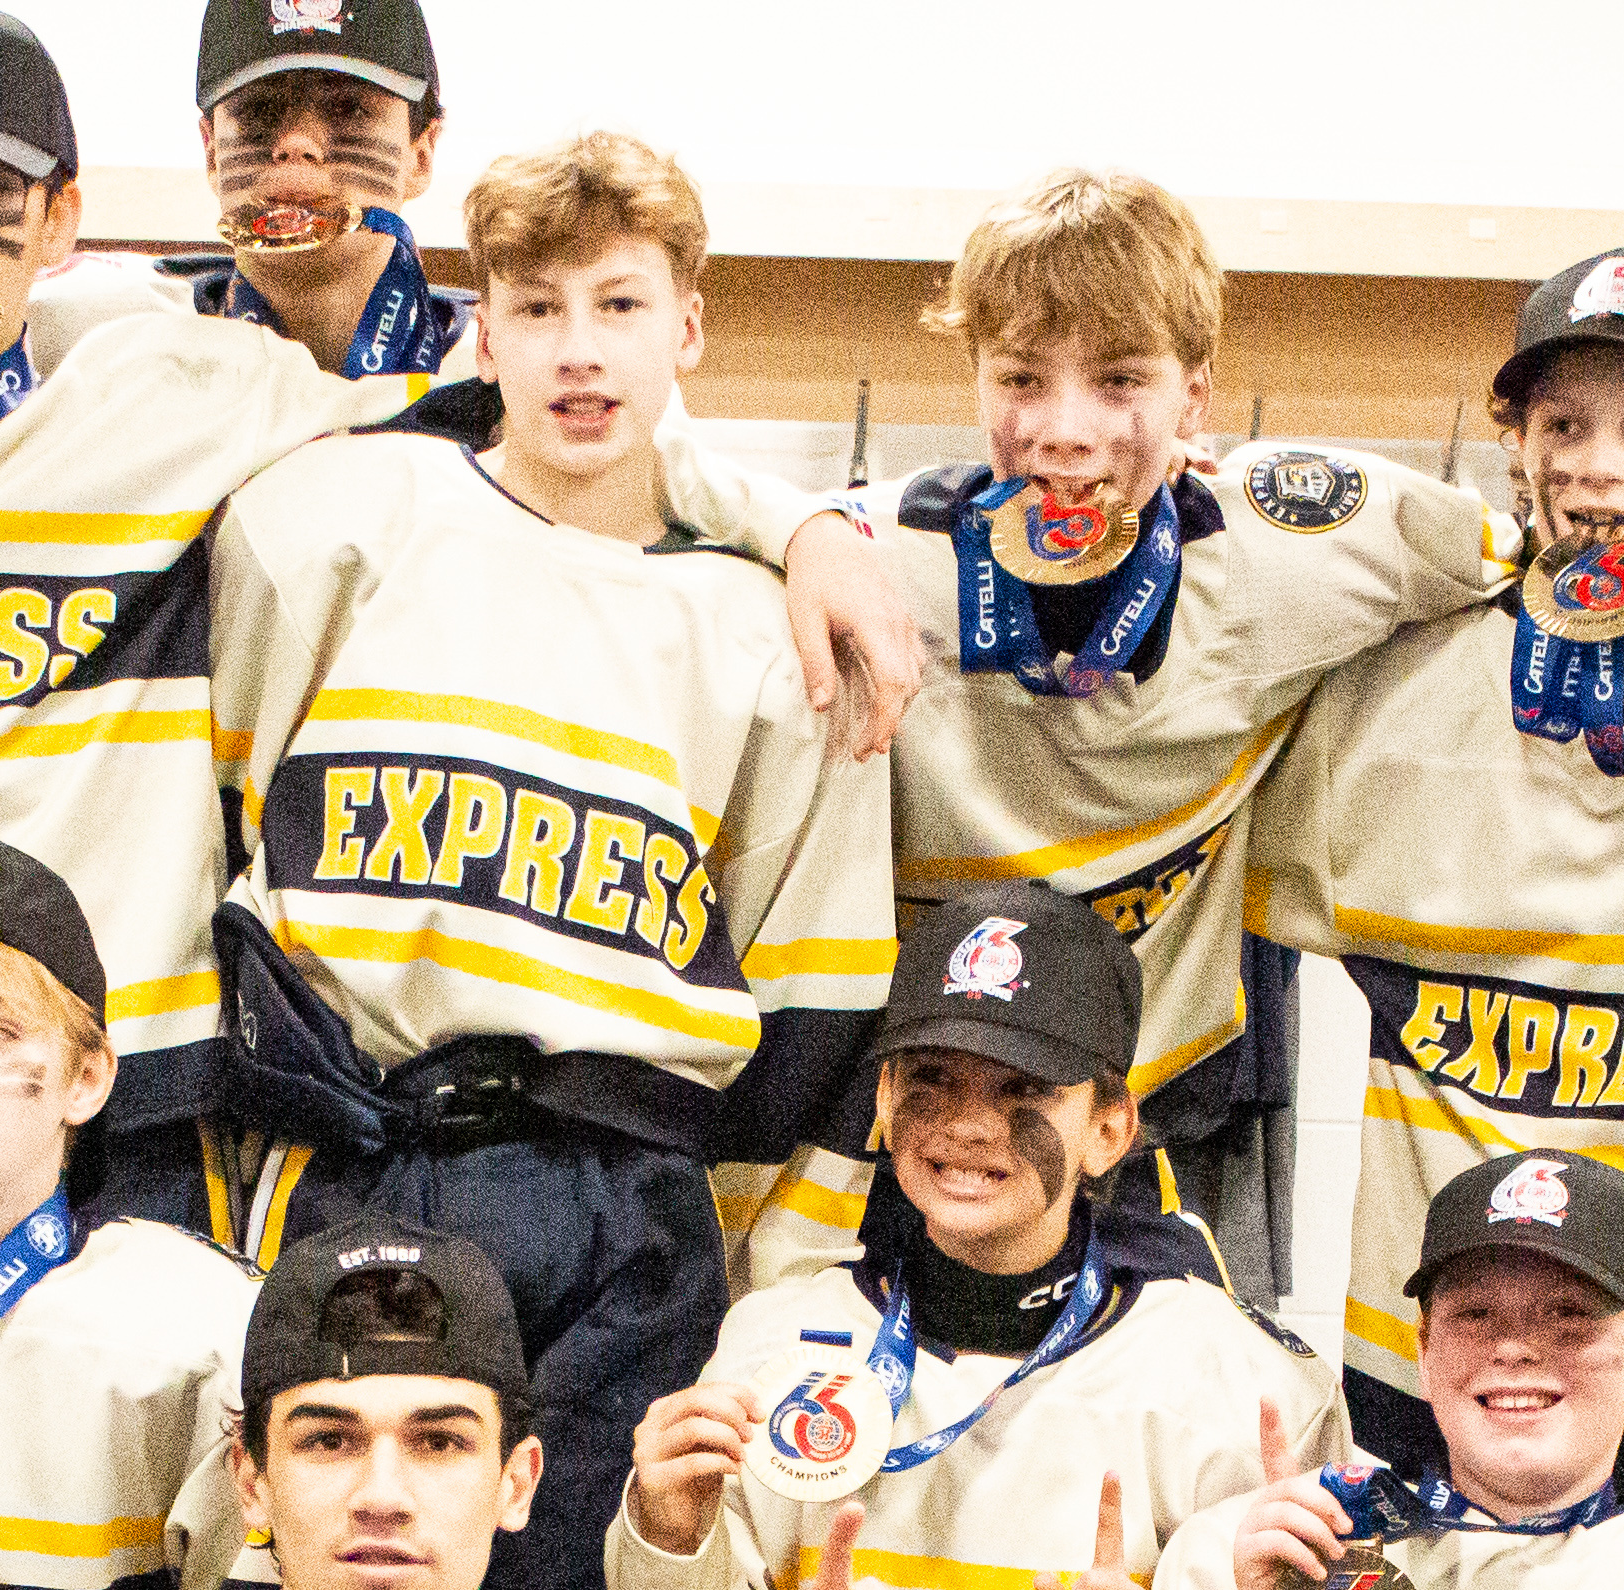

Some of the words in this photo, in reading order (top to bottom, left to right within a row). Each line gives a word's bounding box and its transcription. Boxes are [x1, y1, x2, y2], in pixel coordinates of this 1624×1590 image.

[1101, 578, 1156, 656] CATELLI
[313, 765, 717, 972] EXPRESS
[768, 1454, 850, 1484] CHAMPIONS
